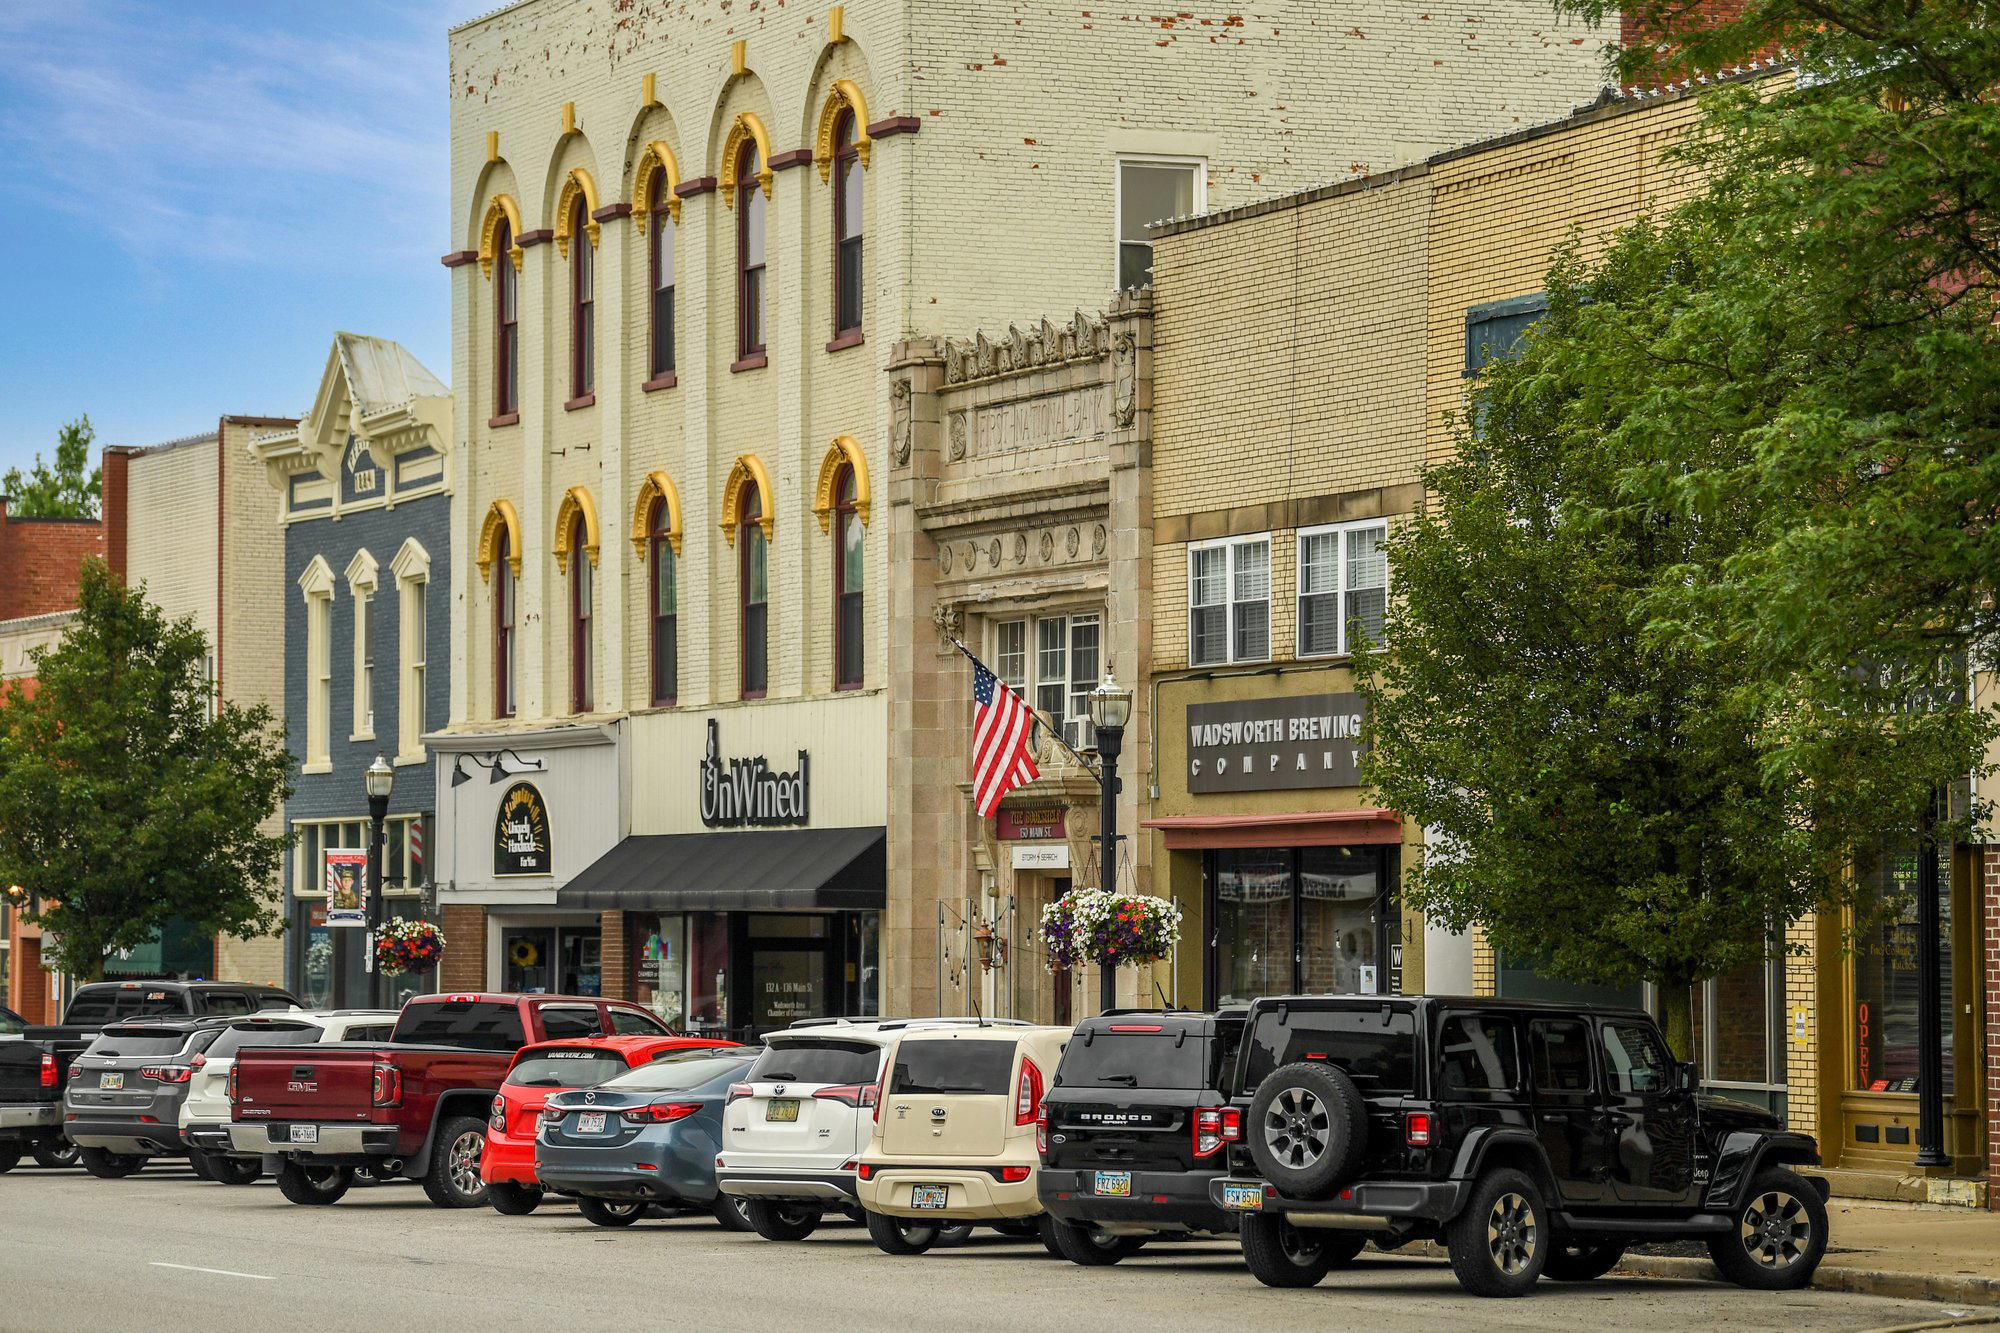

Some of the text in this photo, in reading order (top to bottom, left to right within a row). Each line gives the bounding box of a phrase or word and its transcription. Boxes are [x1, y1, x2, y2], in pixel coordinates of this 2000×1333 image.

[1191, 713, 1361, 747] WADSWORTH BREWING
[1191, 750, 1361, 776] COMPANY
[700, 753, 807, 824] UnWined
[1029, 827, 1043, 838] MAIN
[1021, 853, 1058, 861] STORM SEARCH
[1859, 1003, 1869, 1089] OPEN
[287, 1081, 318, 1092] GMC
[1081, 1113, 1152, 1121] BRONCO
[1693, 1168, 1709, 1179] Jeep
[1096, 1177, 1129, 1191] FRZ 6920
[1241, 1188, 1260, 1203] 8570
